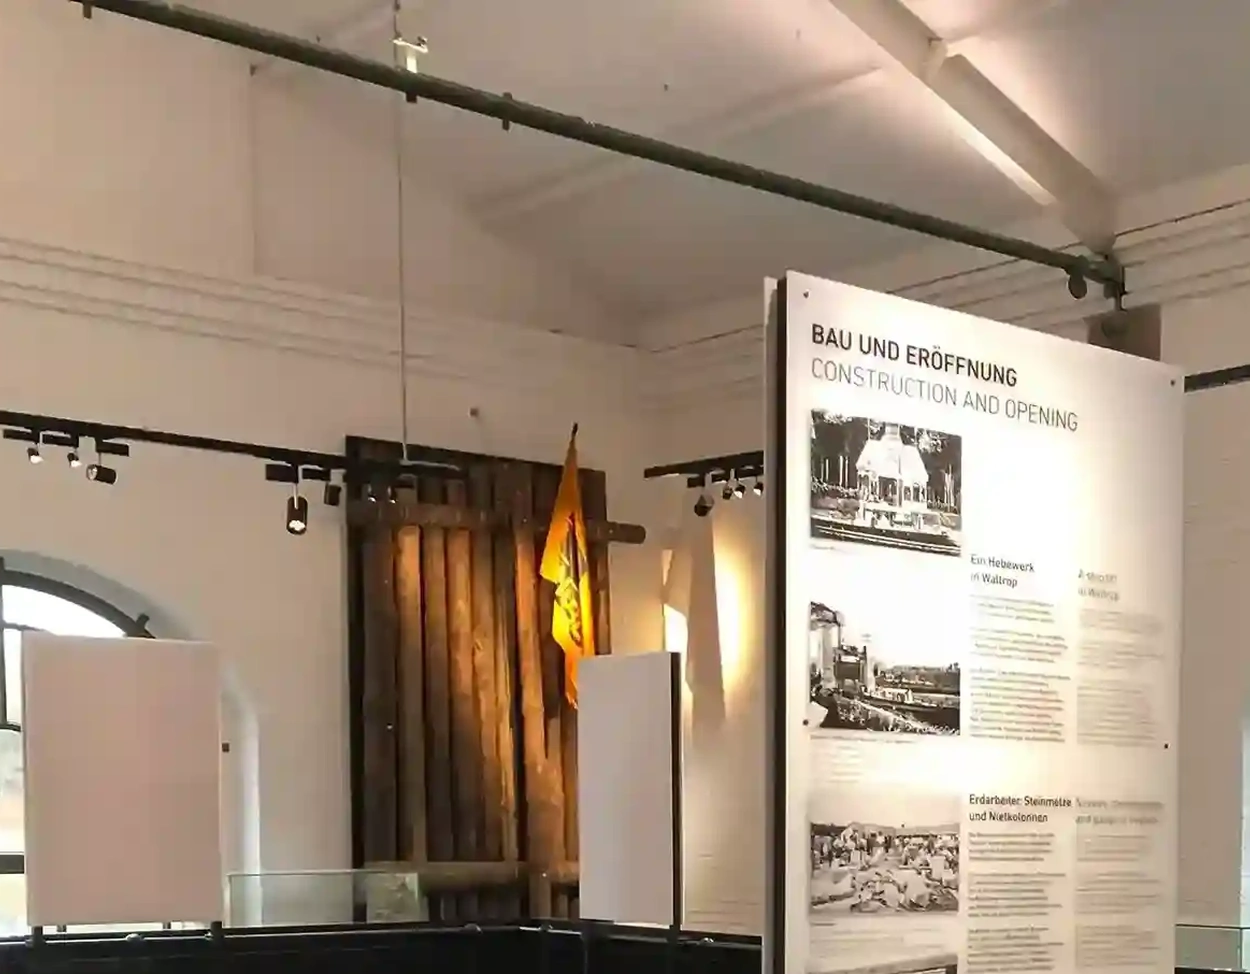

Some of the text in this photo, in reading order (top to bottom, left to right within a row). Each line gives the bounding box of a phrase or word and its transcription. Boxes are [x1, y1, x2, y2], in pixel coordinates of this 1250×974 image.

[811, 323, 1018, 388] BAU UND ERÖFFNUNG
[811, 357, 1079, 433] CONSTRUCTION AND OPENING
[987, 556, 1035, 573] Hebewerk
[981, 572, 1018, 588] Waltrop
[969, 811, 1048, 823] und Nietkolonnen
